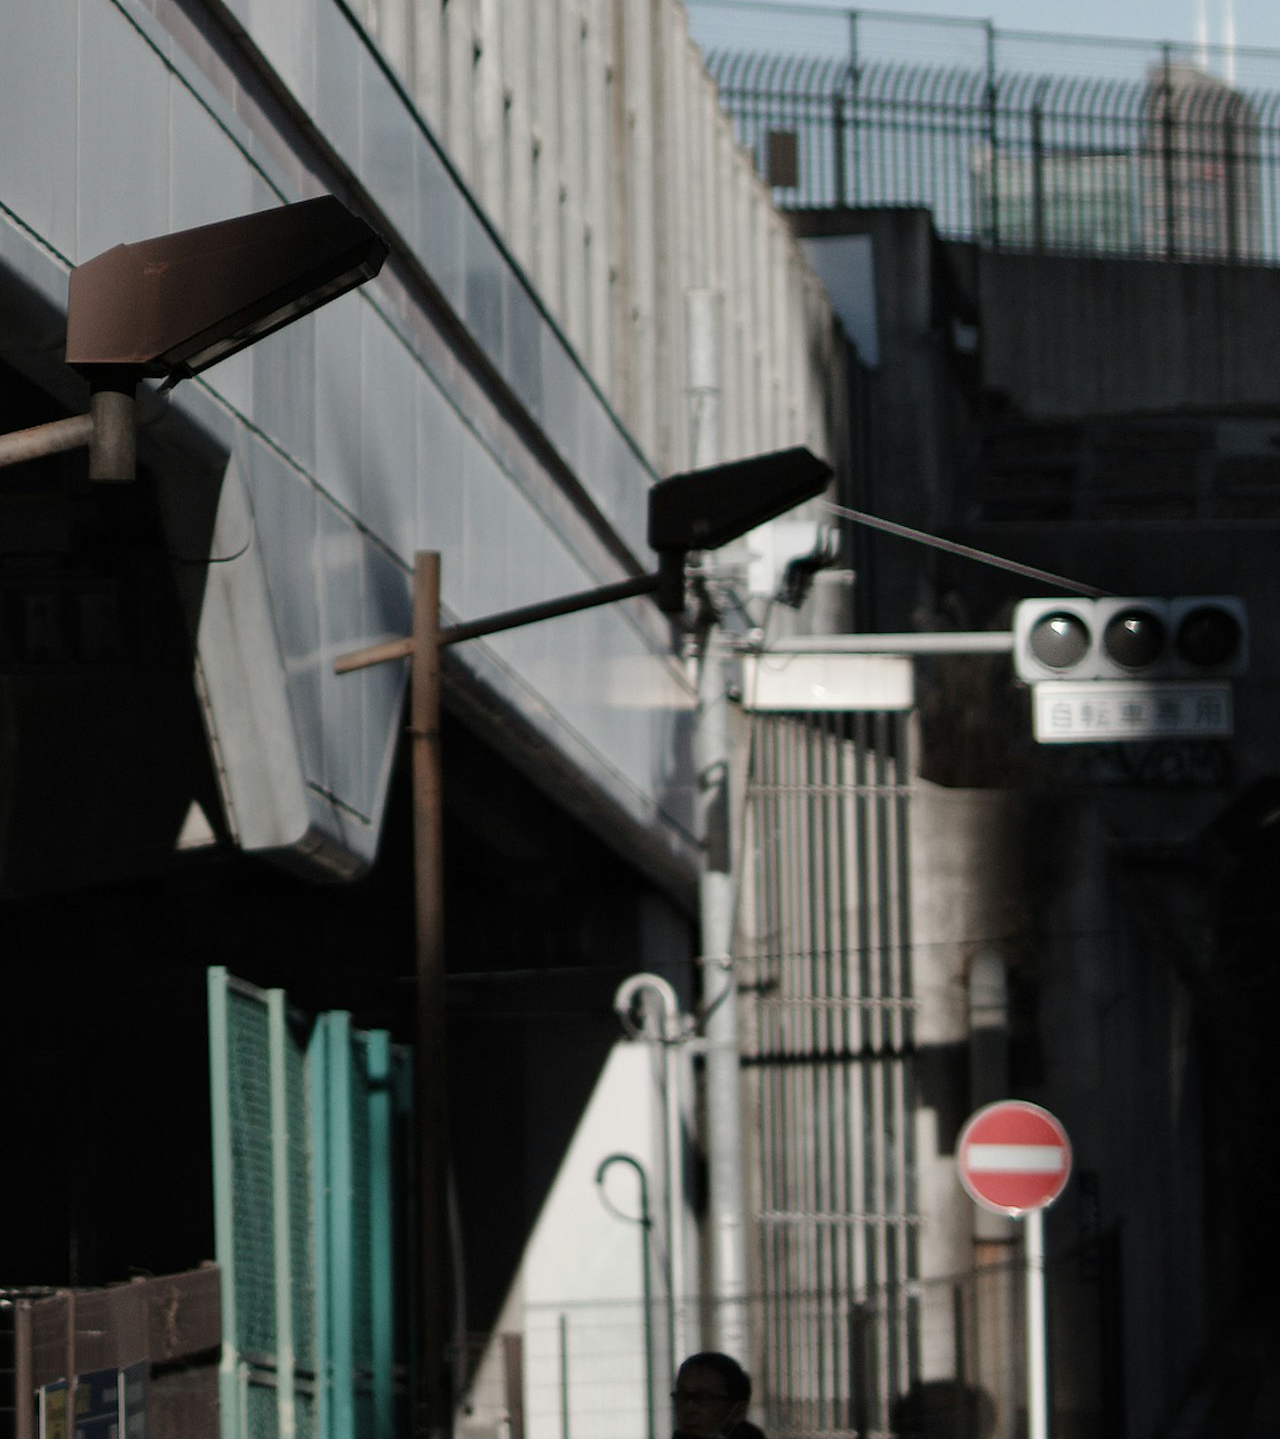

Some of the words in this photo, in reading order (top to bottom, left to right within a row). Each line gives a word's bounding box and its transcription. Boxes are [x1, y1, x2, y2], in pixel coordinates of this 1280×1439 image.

[1051, 696, 1222, 728] 自転車専用
